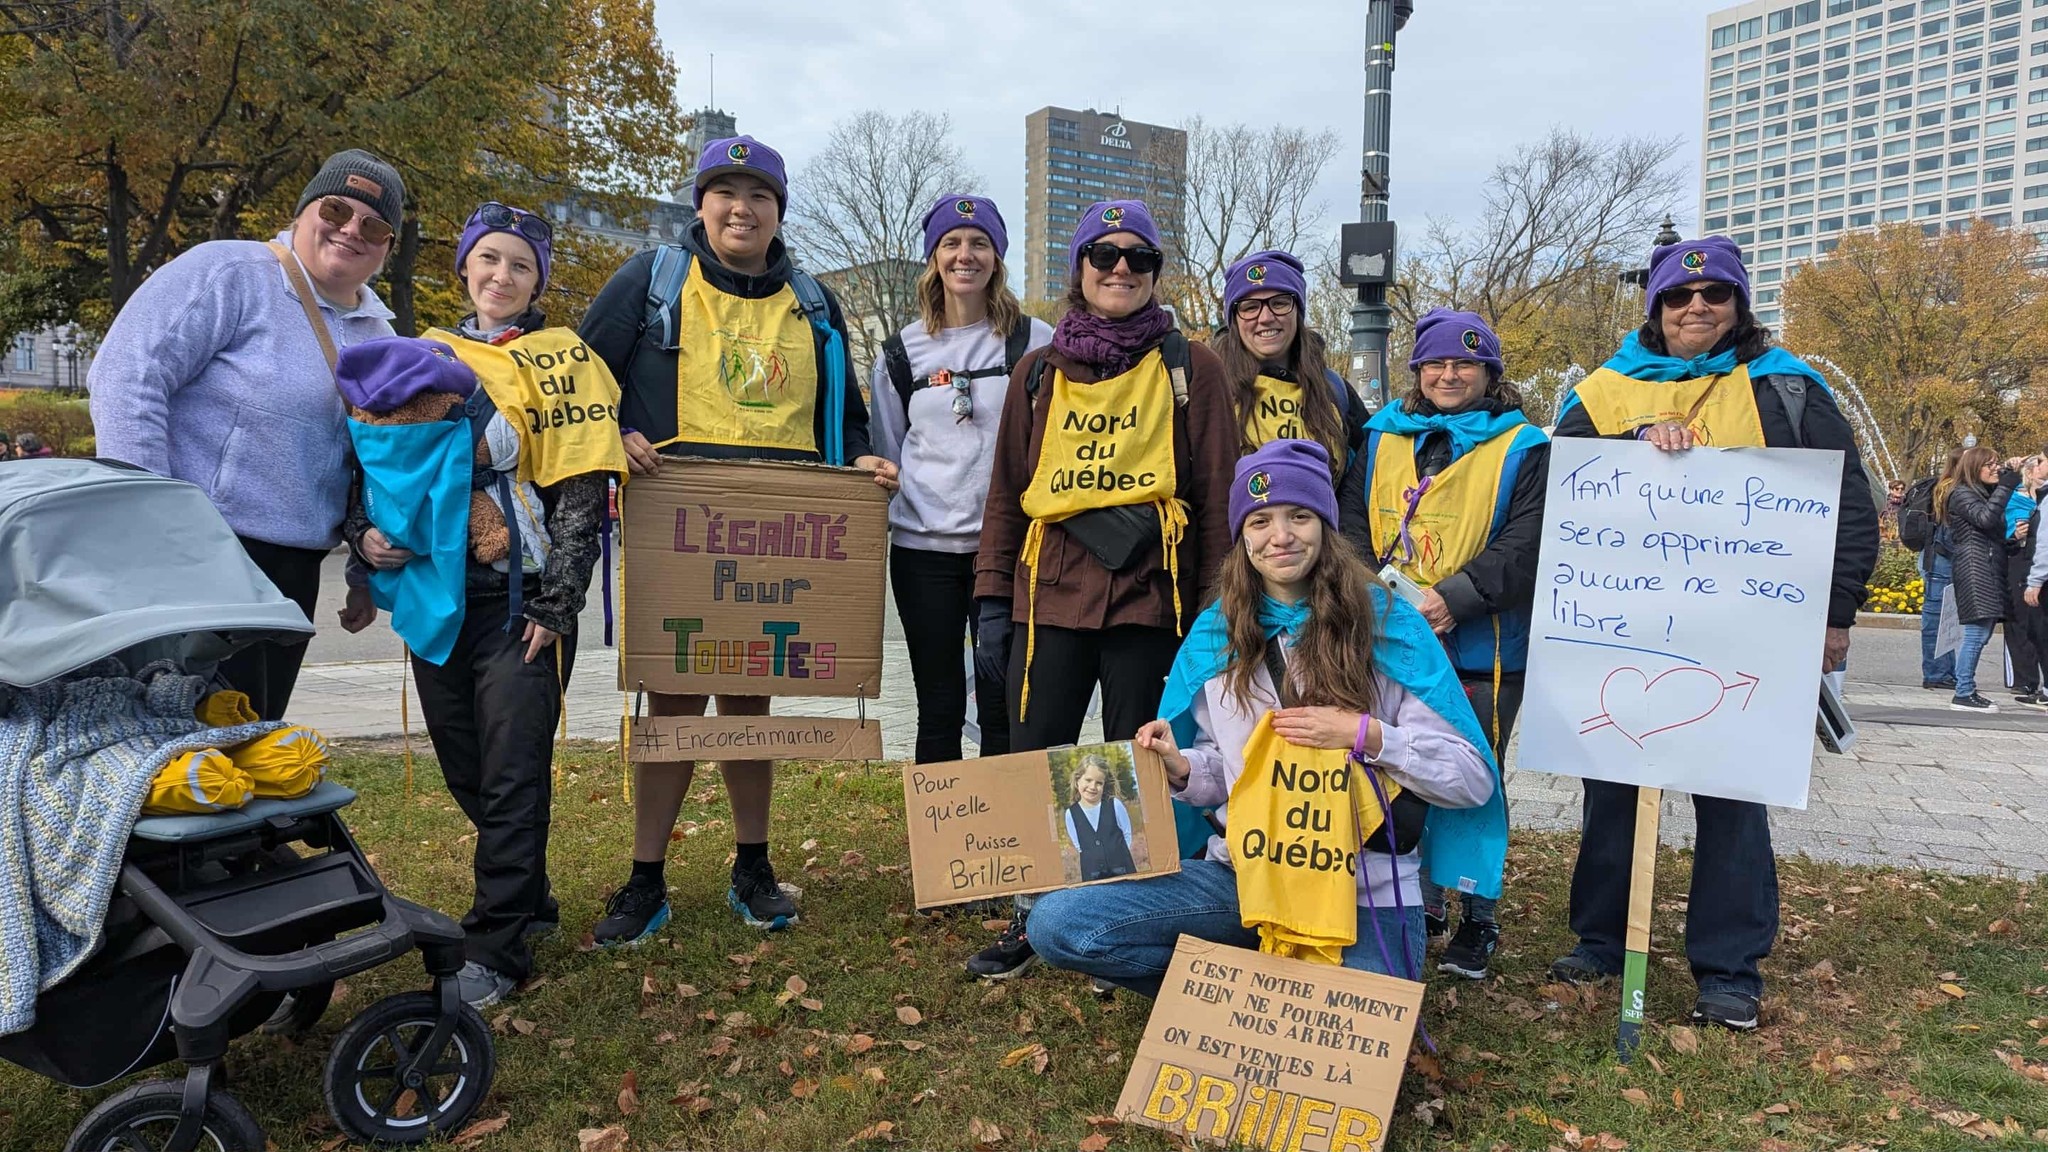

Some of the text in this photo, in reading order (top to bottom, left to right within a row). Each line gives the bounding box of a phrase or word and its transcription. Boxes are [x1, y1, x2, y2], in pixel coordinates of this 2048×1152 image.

[1100, 135, 1132, 150] DELTA
[509, 342, 590, 370] Nord
[539, 374, 576, 396] du
[1063, 405, 1137, 435] Nord
[1261, 395, 1304, 419] Nor
[1076, 440, 1116, 461] du
[1050, 464, 1156, 494] Québec
[1735, 476, 1831, 527] femme
[1553, 562, 1806, 604] aucune ne sera
[1552, 587, 1631, 638] libre
[912, 772, 960, 795] Pour
[1271, 759, 1351, 794] Nord
[924, 795, 991, 834] qu'elle
[1285, 801, 1332, 833] du
[949, 855, 1034, 891] Briller
[1189, 959, 1409, 1024] C'EST NOTRE MOMENT
[1245, 993, 1271, 1014] NE
[1279, 1002, 1355, 1033] POURRA
[1227, 1011, 1391, 1060] NOUS ARRÊTER
[1163, 1026, 1354, 1086] ON EST VENUES LÀ
[1232, 1062, 1281, 1090] POUR
